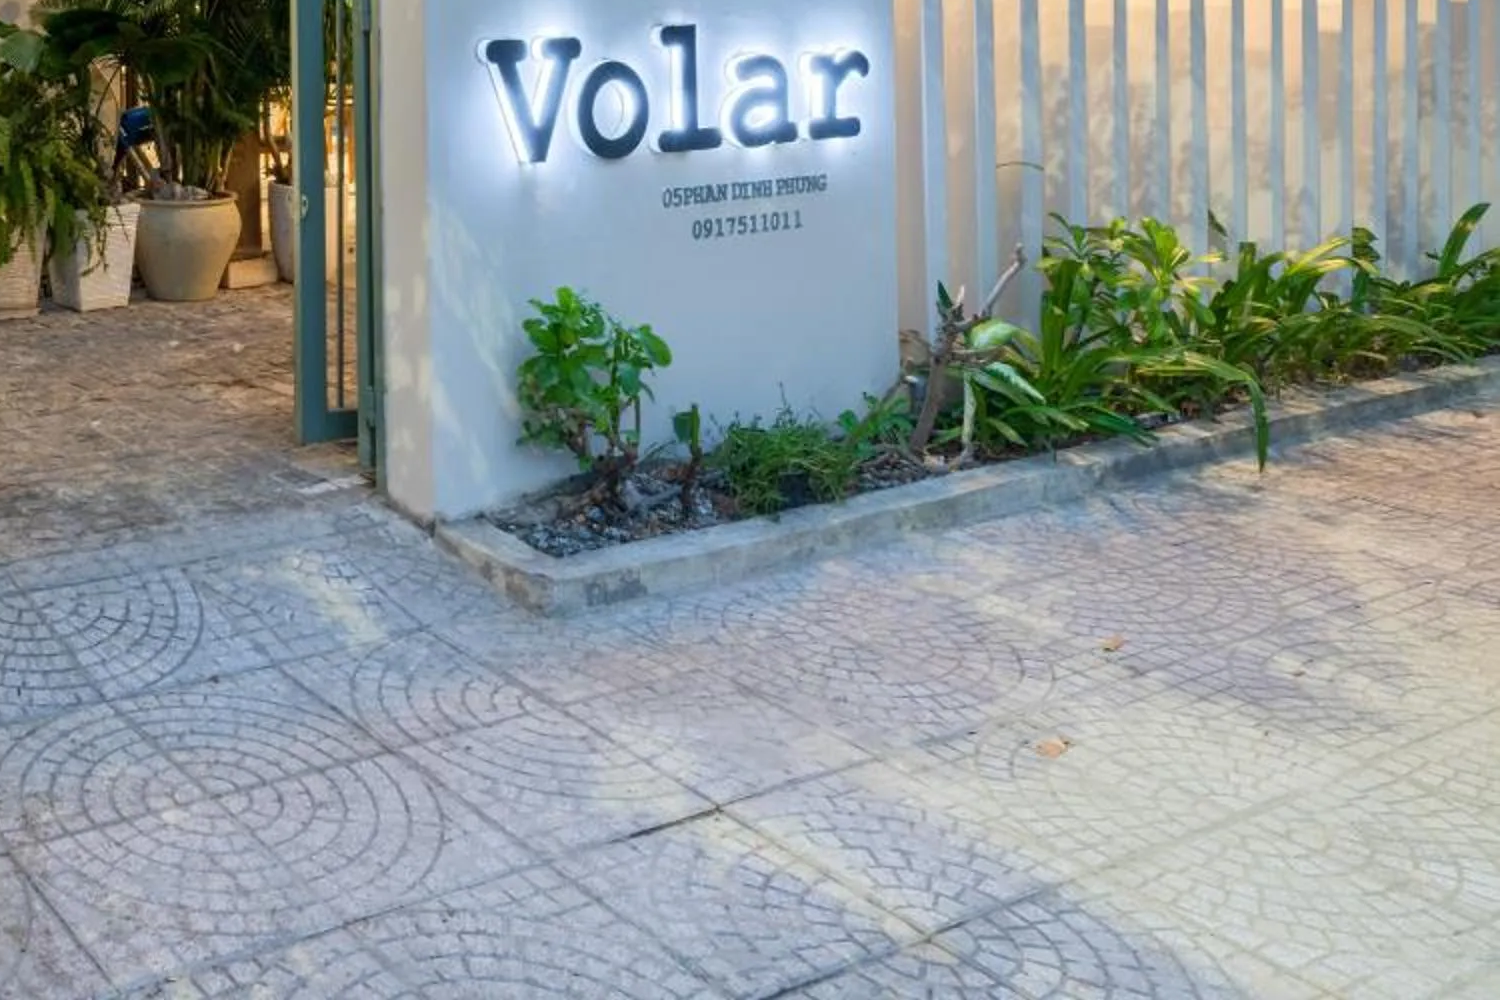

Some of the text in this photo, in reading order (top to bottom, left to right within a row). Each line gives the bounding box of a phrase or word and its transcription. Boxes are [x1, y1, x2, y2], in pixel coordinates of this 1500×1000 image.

[479, 22, 870, 164] Volar
[731, 179, 773, 200] DINH
[775, 174, 827, 196] PHUNG
[691, 210, 803, 240] 0917511011
